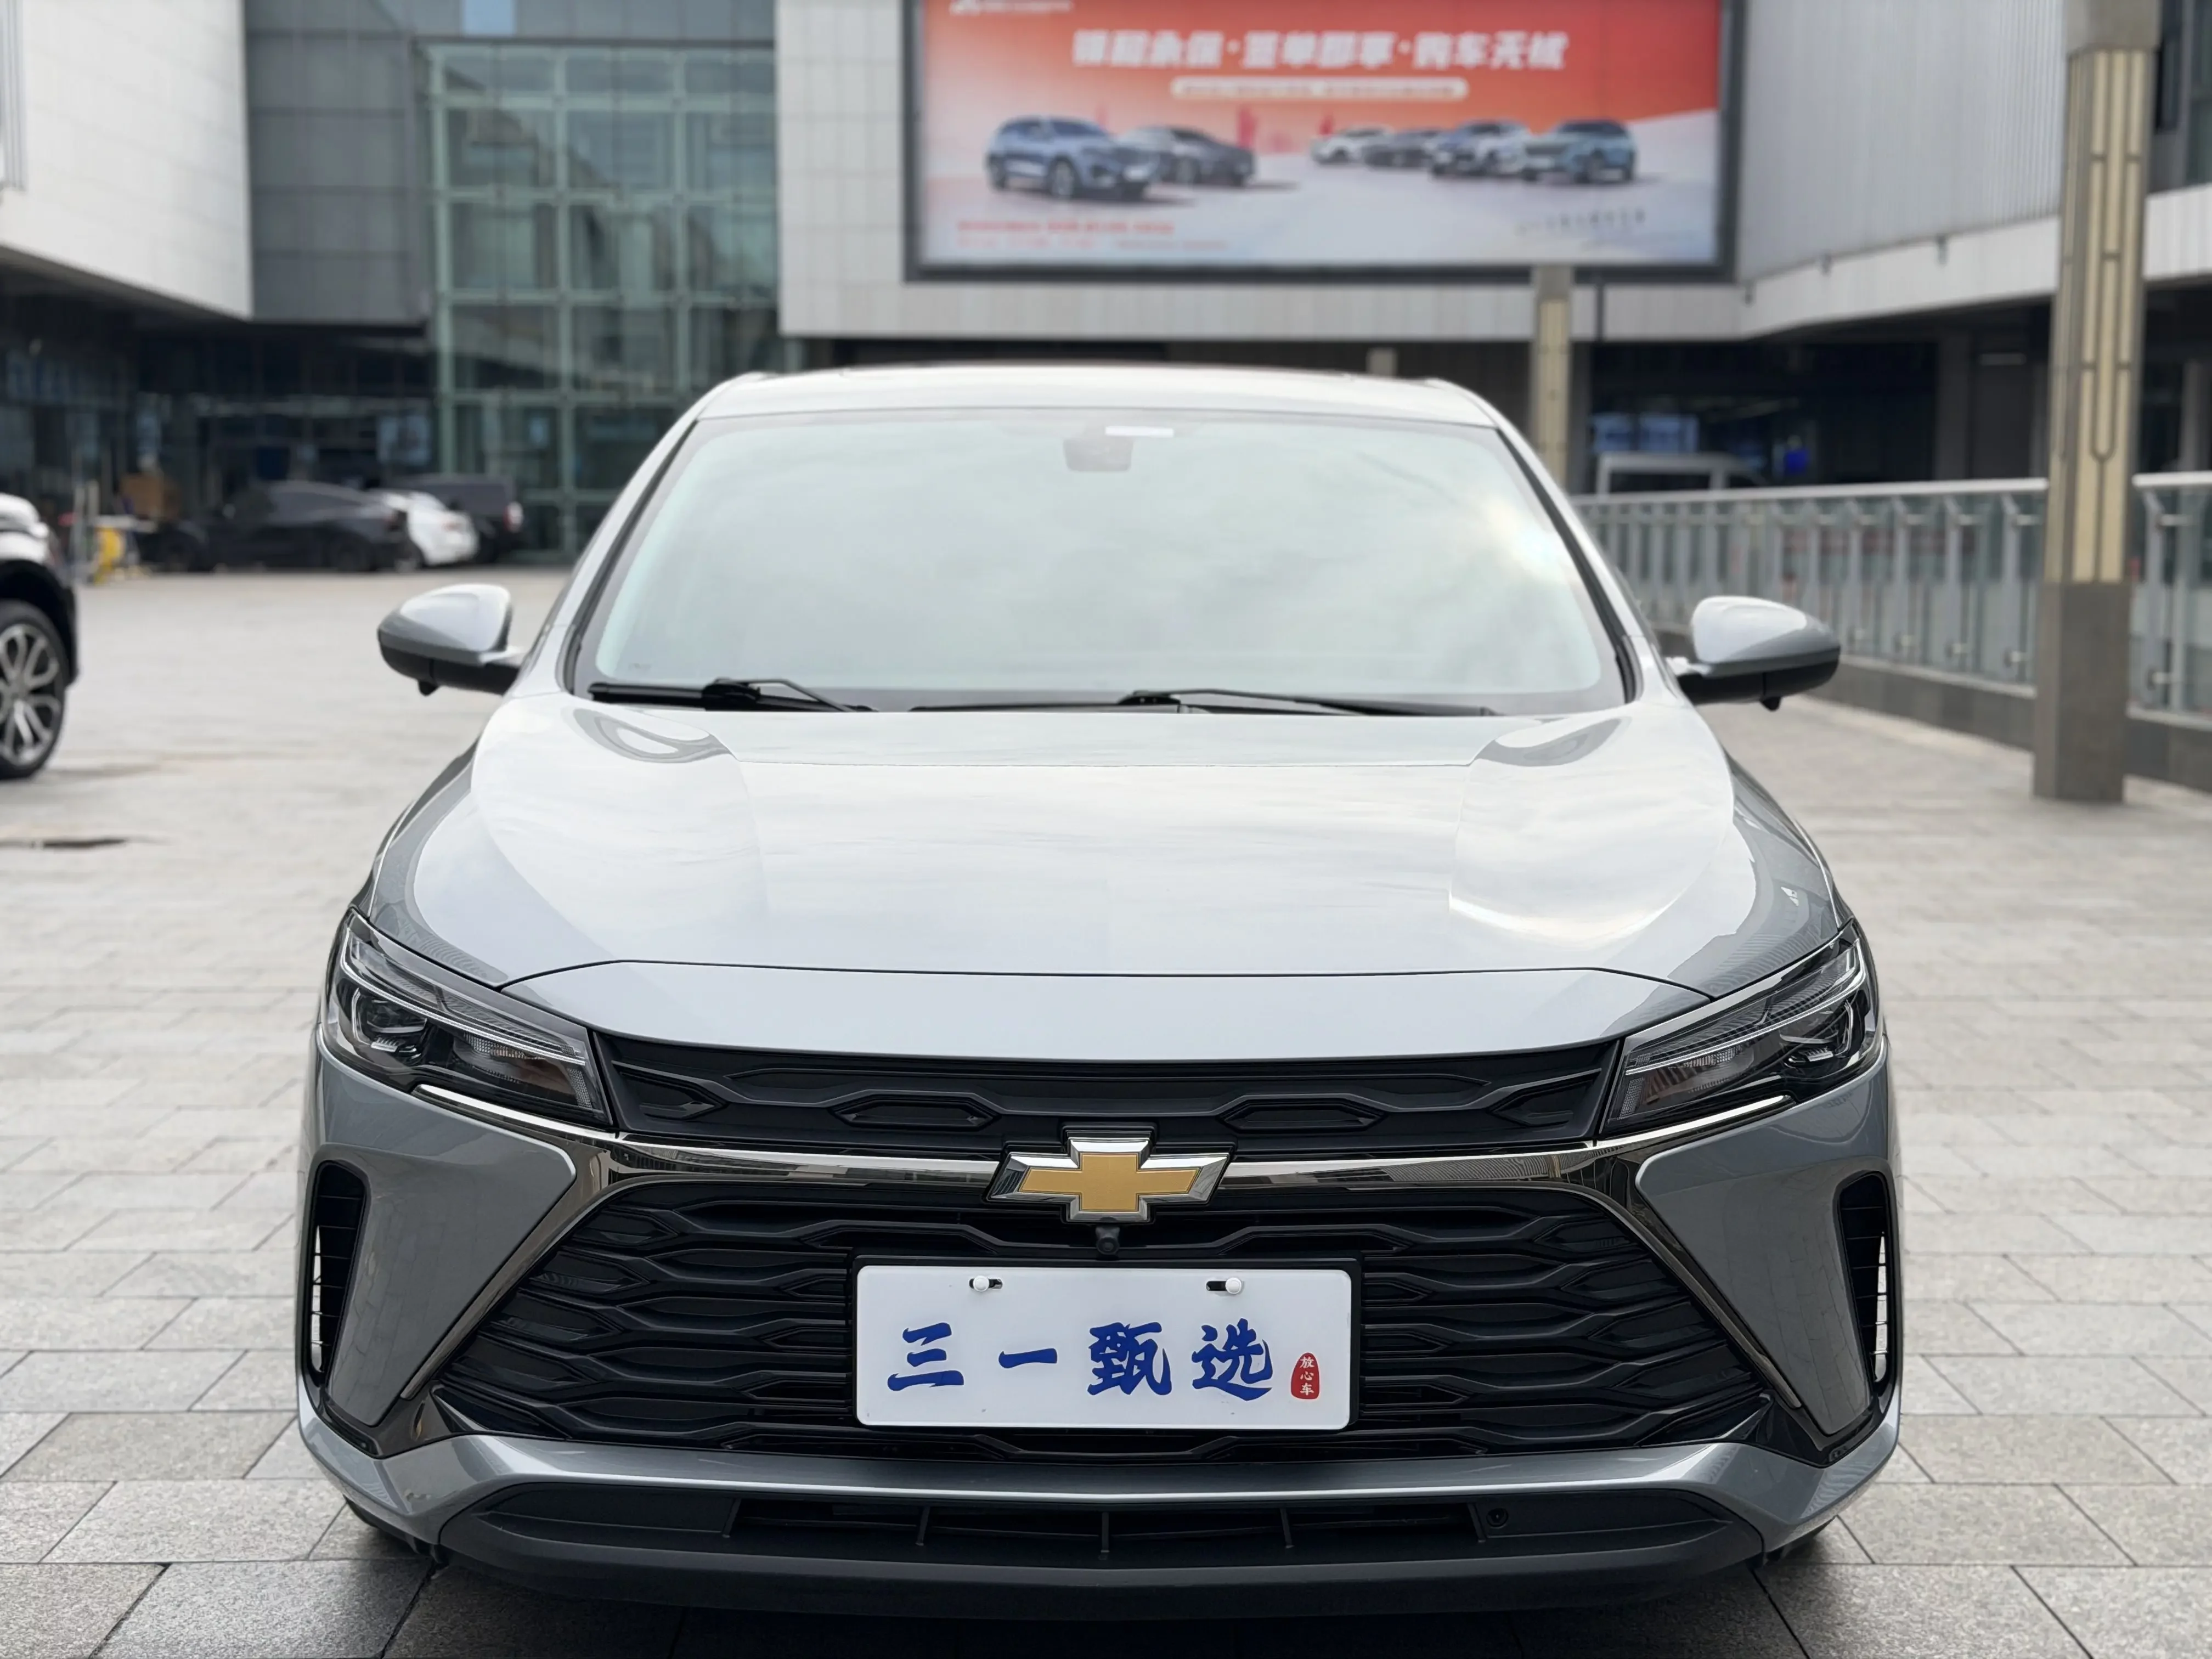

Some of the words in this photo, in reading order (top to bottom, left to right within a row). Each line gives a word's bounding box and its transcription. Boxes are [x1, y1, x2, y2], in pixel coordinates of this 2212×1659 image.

[887, 1319, 1273, 1401] 三一甄选
[1299, 1356, 1314, 1395] 放心车
